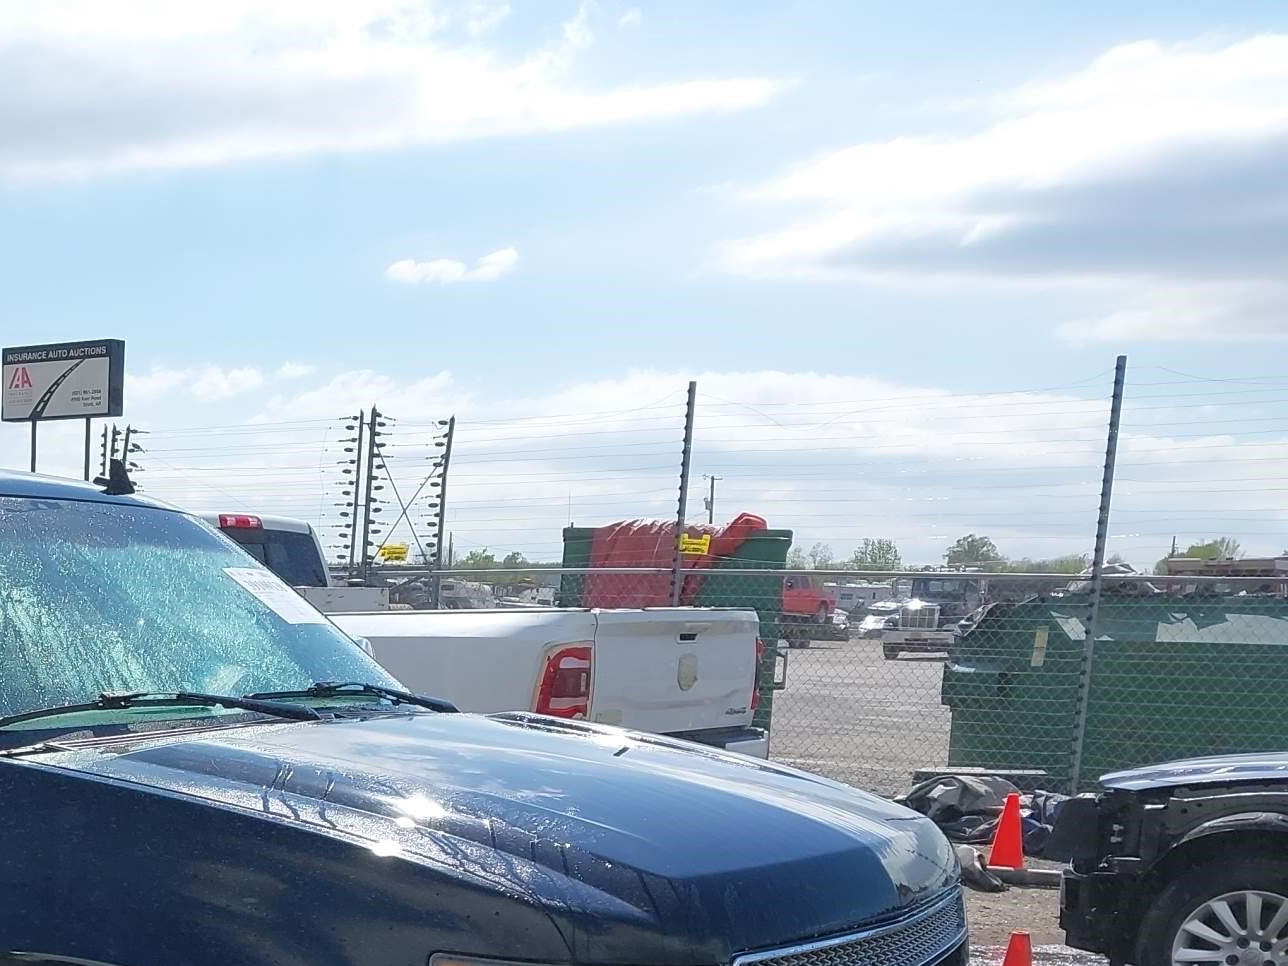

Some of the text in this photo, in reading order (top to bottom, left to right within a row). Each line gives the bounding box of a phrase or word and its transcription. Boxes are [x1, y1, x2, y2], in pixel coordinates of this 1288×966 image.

[7, 346, 106, 361] INSURANCE AUTO AUCTIONS
